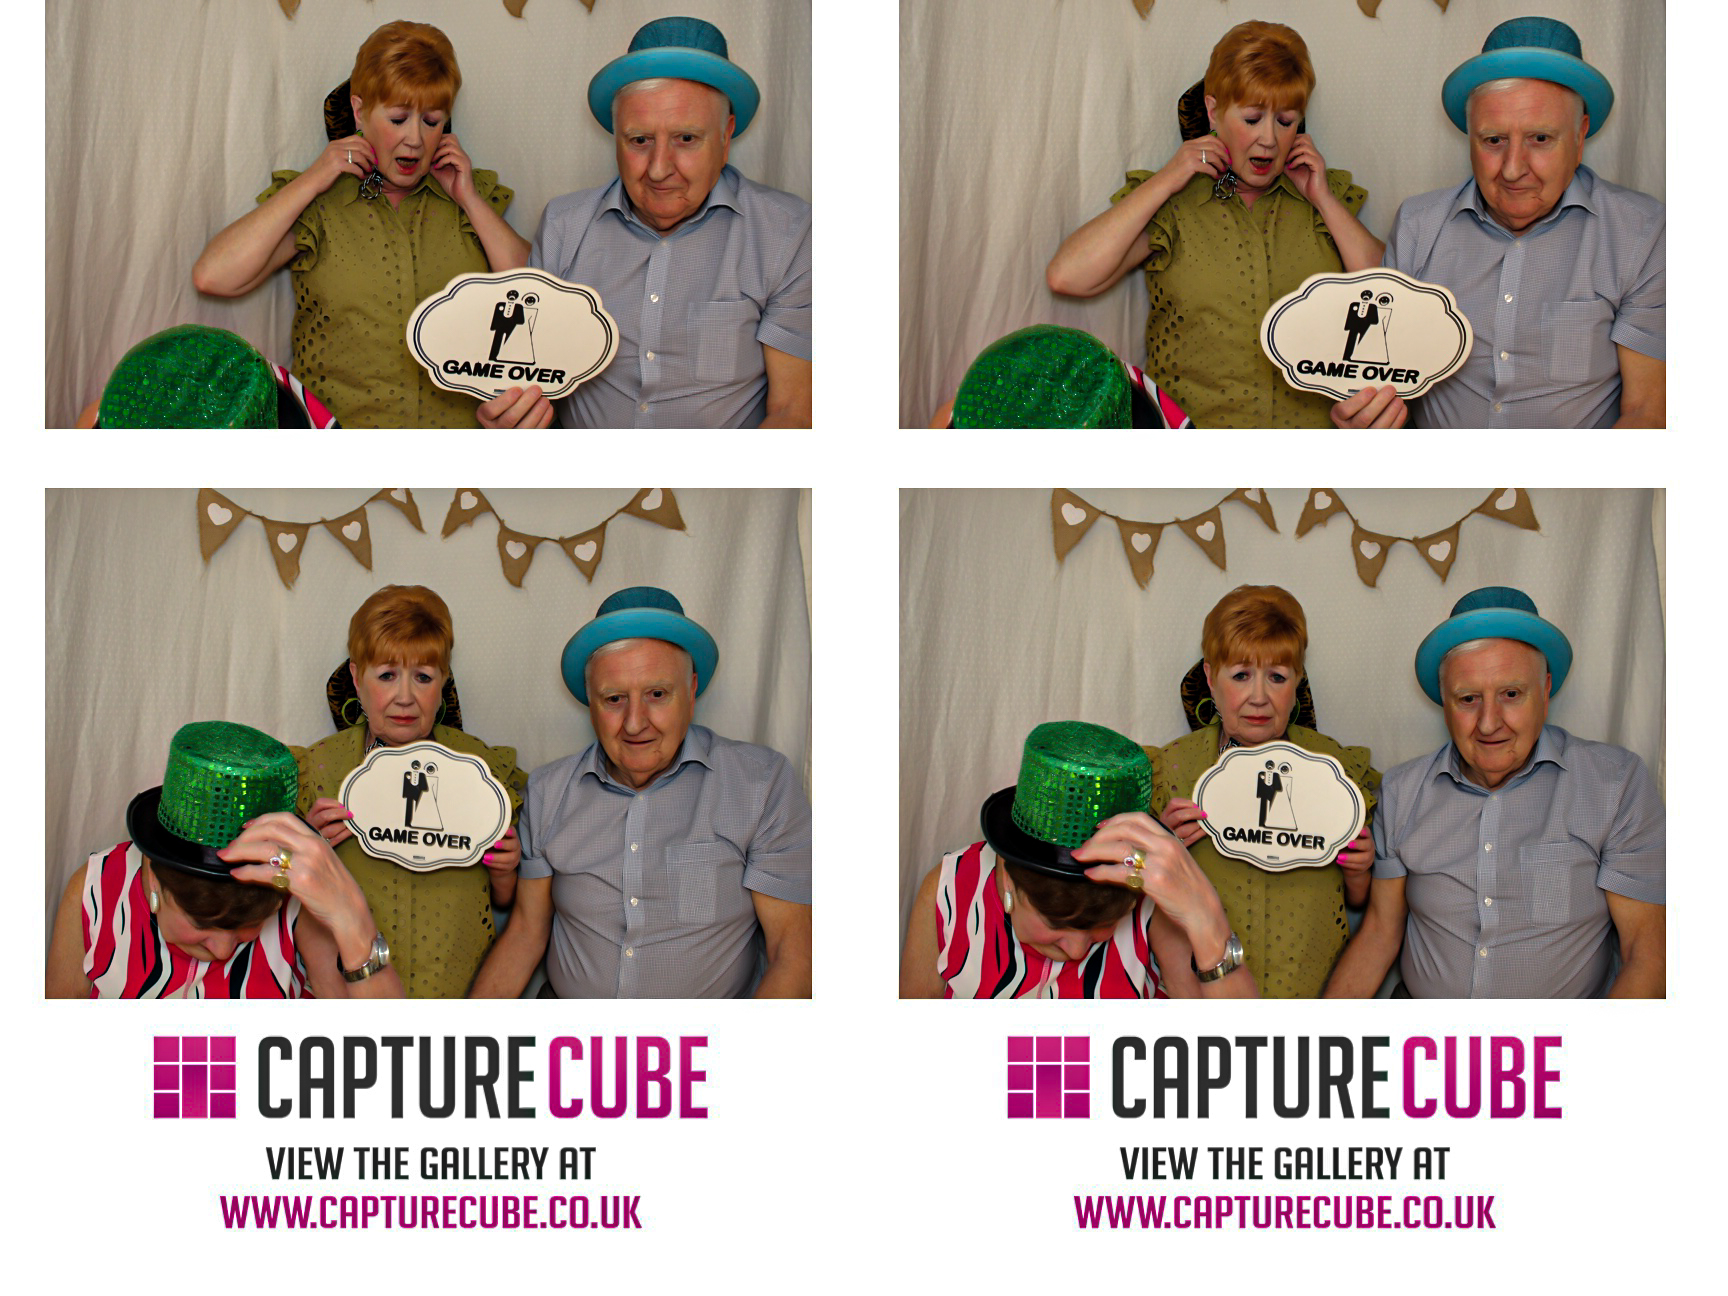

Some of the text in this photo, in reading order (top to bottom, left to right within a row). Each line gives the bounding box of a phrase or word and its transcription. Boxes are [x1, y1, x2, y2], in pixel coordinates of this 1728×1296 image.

[442, 359, 566, 384] GAME OVER
[1296, 359, 1420, 384] GAME OVER
[368, 826, 471, 850] GAME OVER
[1222, 826, 1325, 850] GAME OVER
